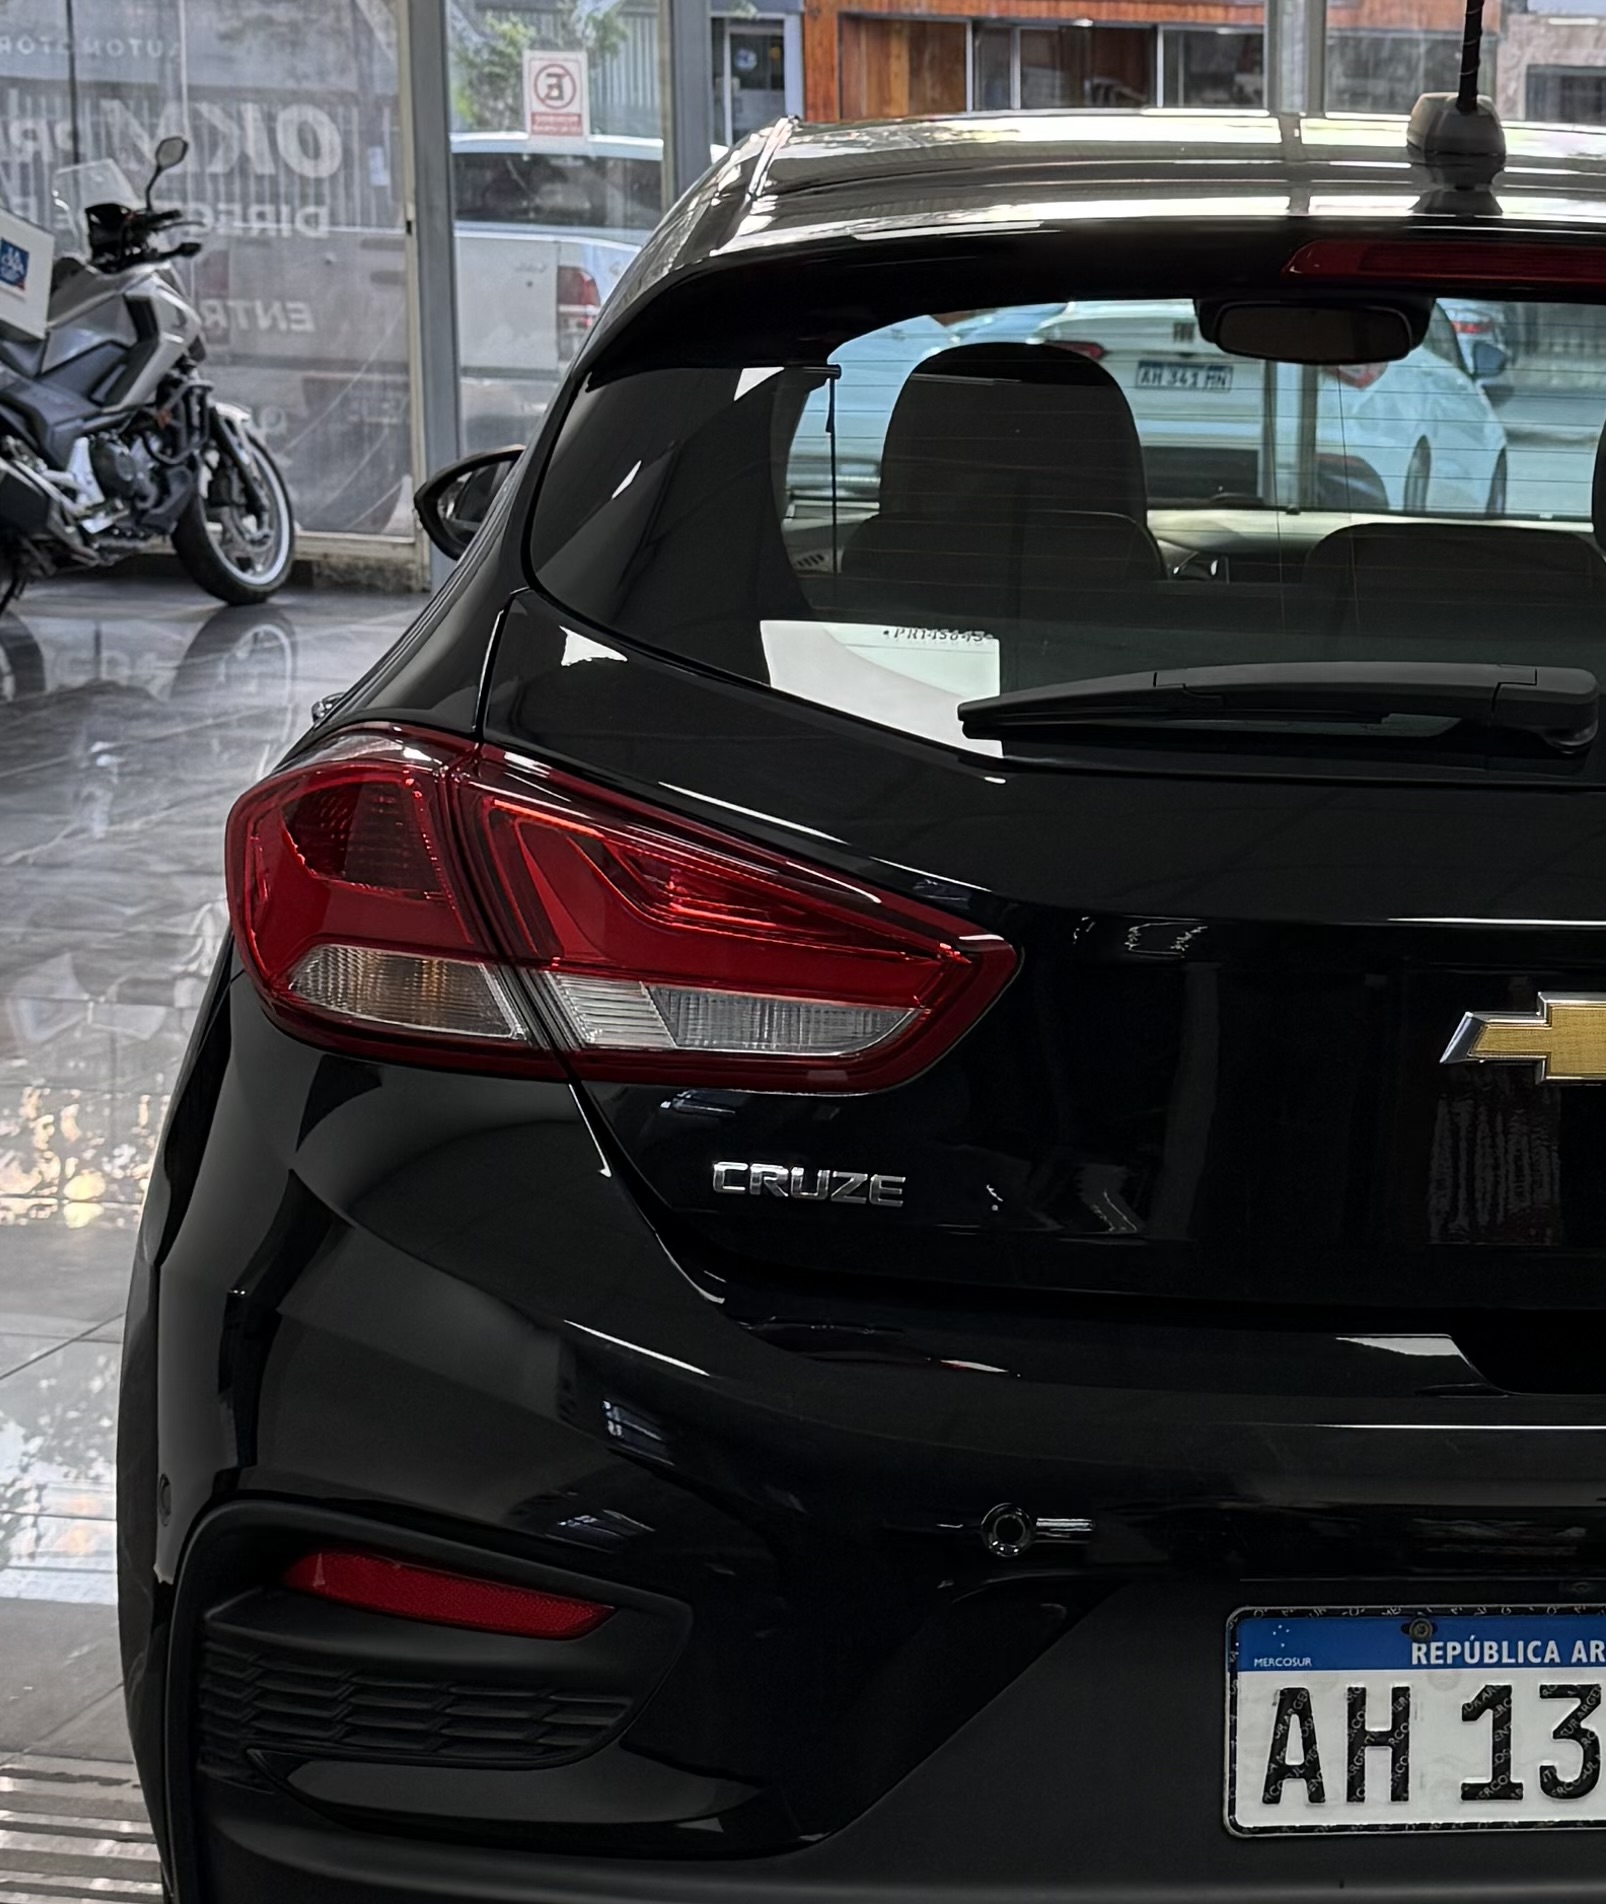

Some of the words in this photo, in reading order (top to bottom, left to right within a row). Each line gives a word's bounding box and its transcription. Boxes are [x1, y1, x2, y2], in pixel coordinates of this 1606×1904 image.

[712, 1160, 906, 1208] CRUZE
[1253, 1657, 1313, 1668] MERCOSUR
[1411, 1634, 1561, 1665] REPÚBLICA
[1261, 1686, 1412, 1805] AH
